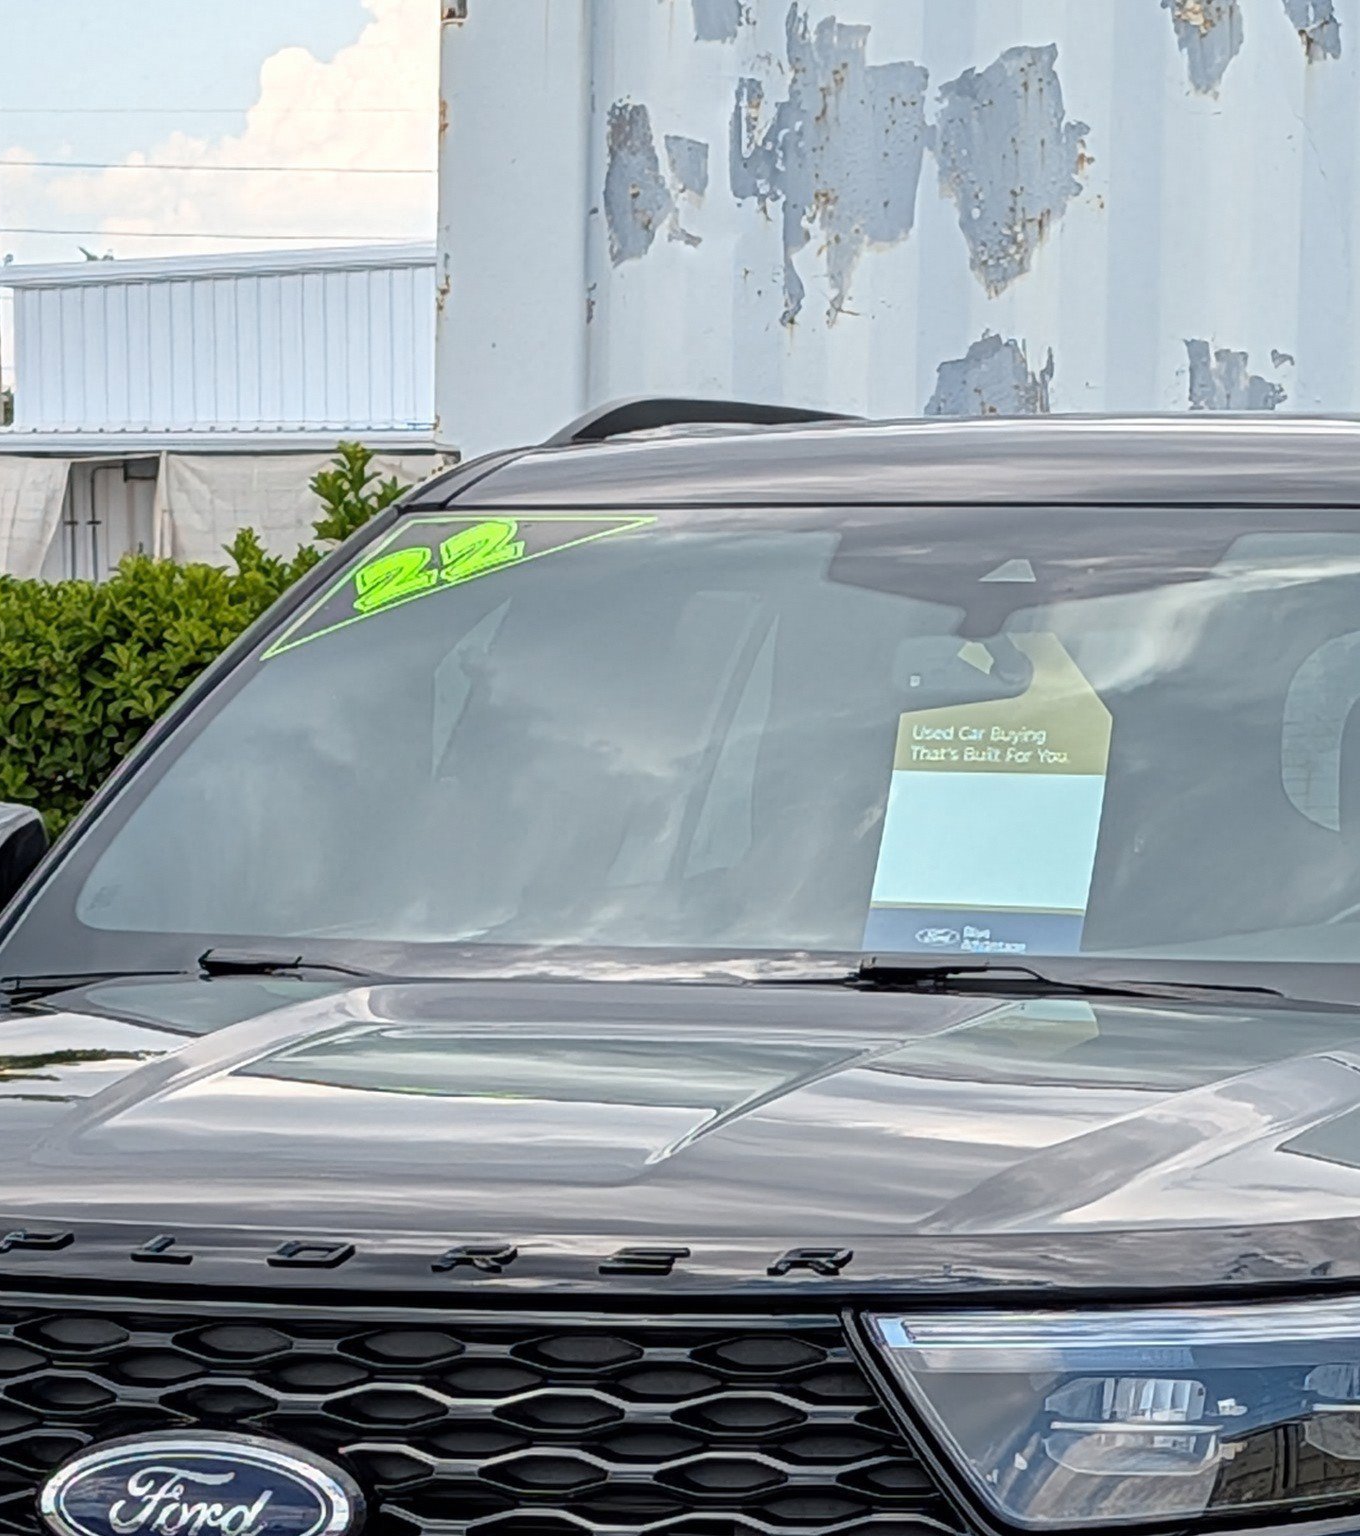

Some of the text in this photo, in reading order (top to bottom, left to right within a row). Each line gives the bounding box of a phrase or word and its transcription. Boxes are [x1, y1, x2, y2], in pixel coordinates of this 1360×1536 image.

[352, 517, 526, 614] 22
[911, 724, 1047, 745] Used Car Buying
[911, 745, 959, 762] That's
[963, 746, 1001, 763] Built
[1005, 747, 1033, 763] For
